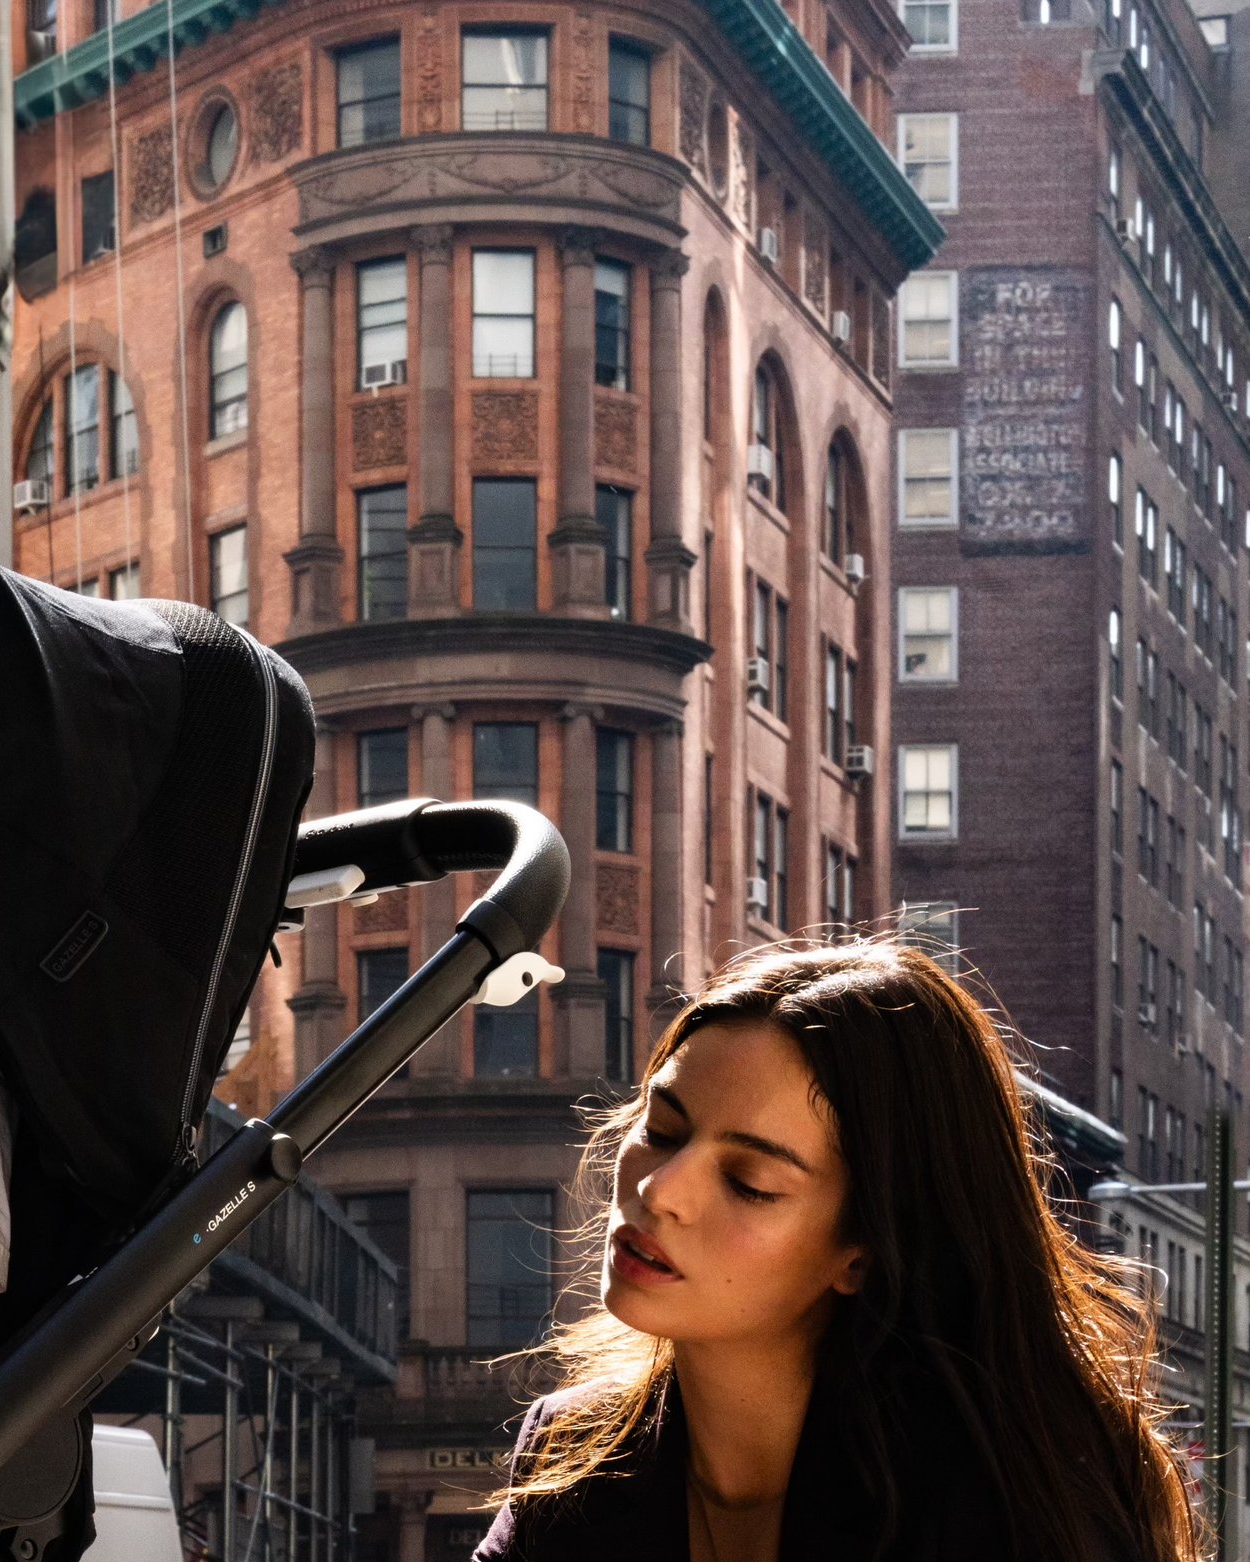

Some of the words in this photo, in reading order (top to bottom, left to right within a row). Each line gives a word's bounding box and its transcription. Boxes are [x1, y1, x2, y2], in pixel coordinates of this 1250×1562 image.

[52, 929, 93, 972] GAZELLE
[88, 920, 99, 930] S
[247, 1181, 256, 1192] S
